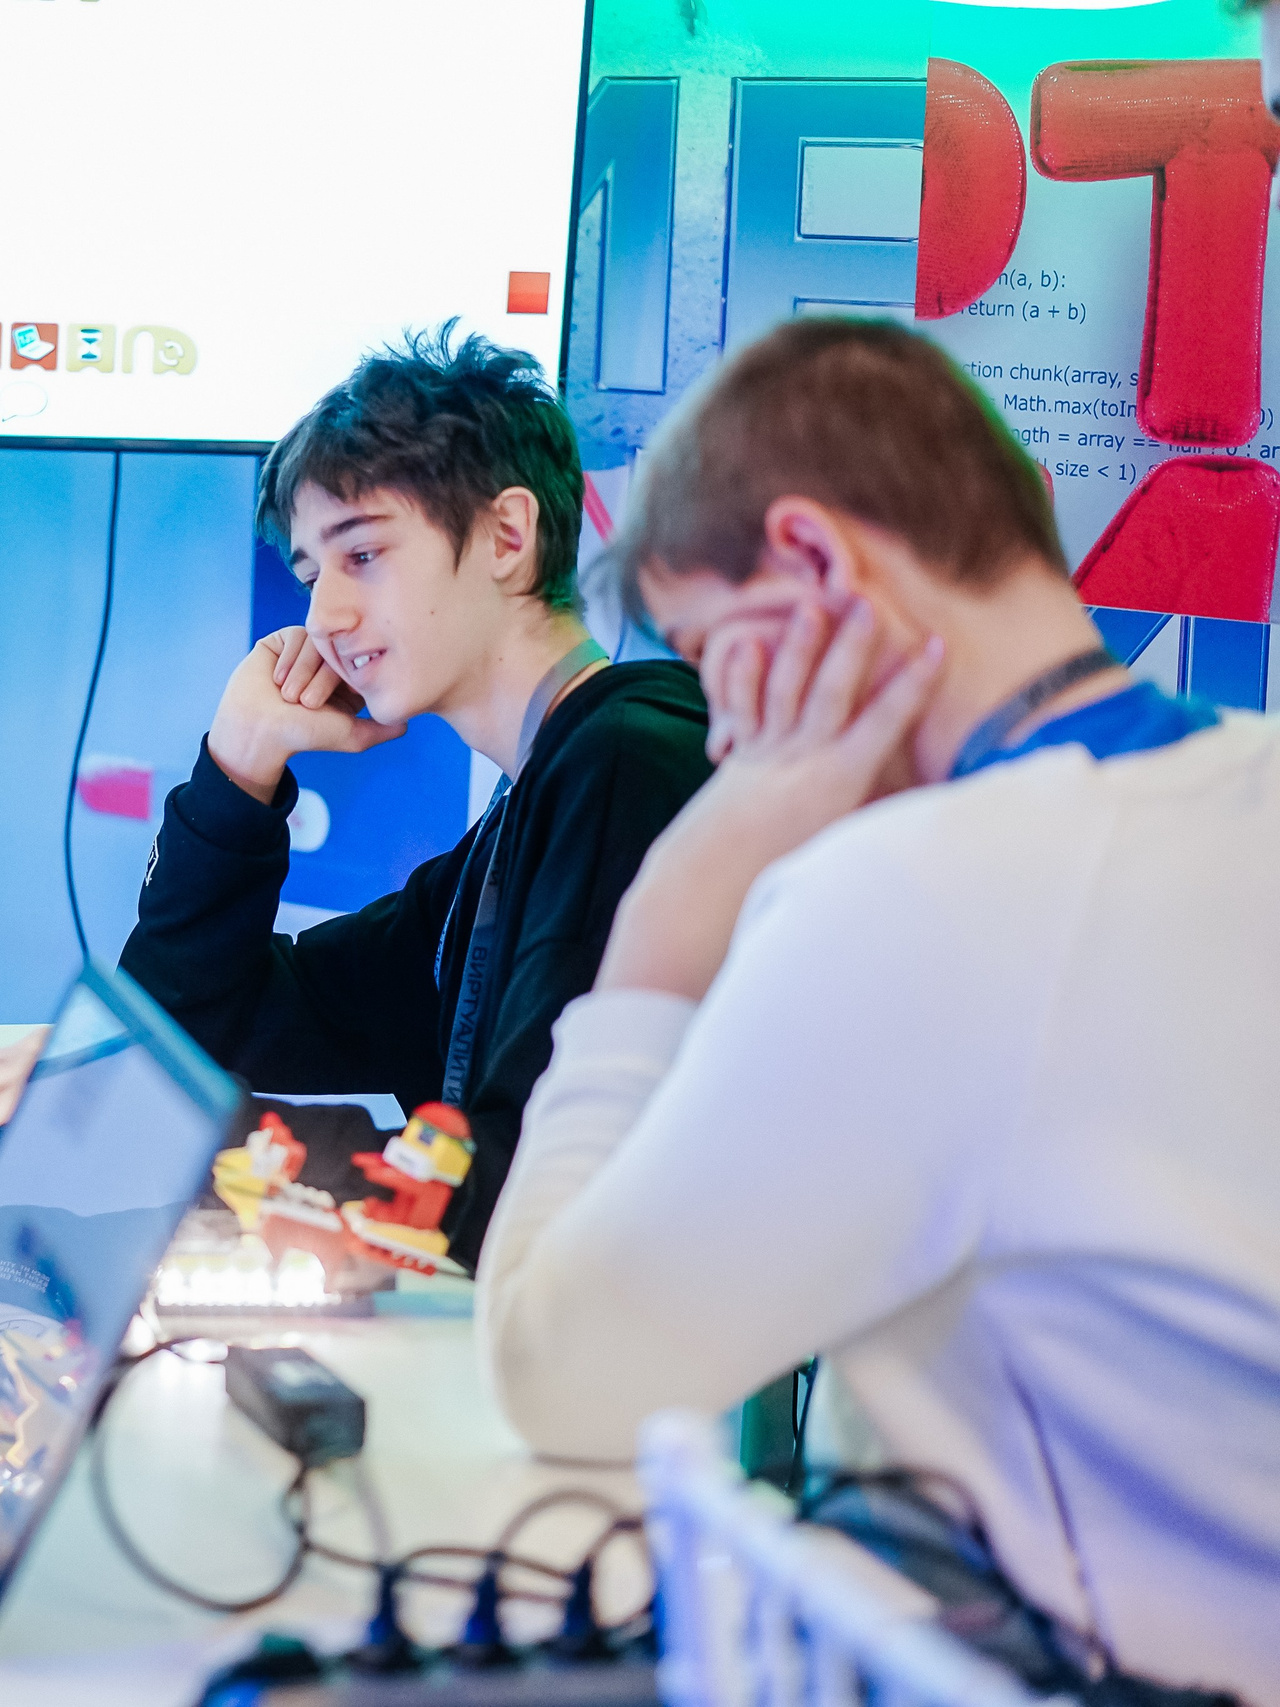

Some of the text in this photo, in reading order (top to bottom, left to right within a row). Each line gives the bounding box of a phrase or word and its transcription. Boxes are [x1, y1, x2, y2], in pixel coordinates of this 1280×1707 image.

[1040, 270, 1066, 292] b):
[1022, 301, 1040, 322] (a
[1048, 305, 1060, 318] +
[1068, 302, 1086, 325] b)
[1010, 363, 1122, 389] chunk(array,
[1077, 431, 1125, 452] array
[1055, 460, 1089, 478] size
[1119, 463, 1137, 485] 1)
